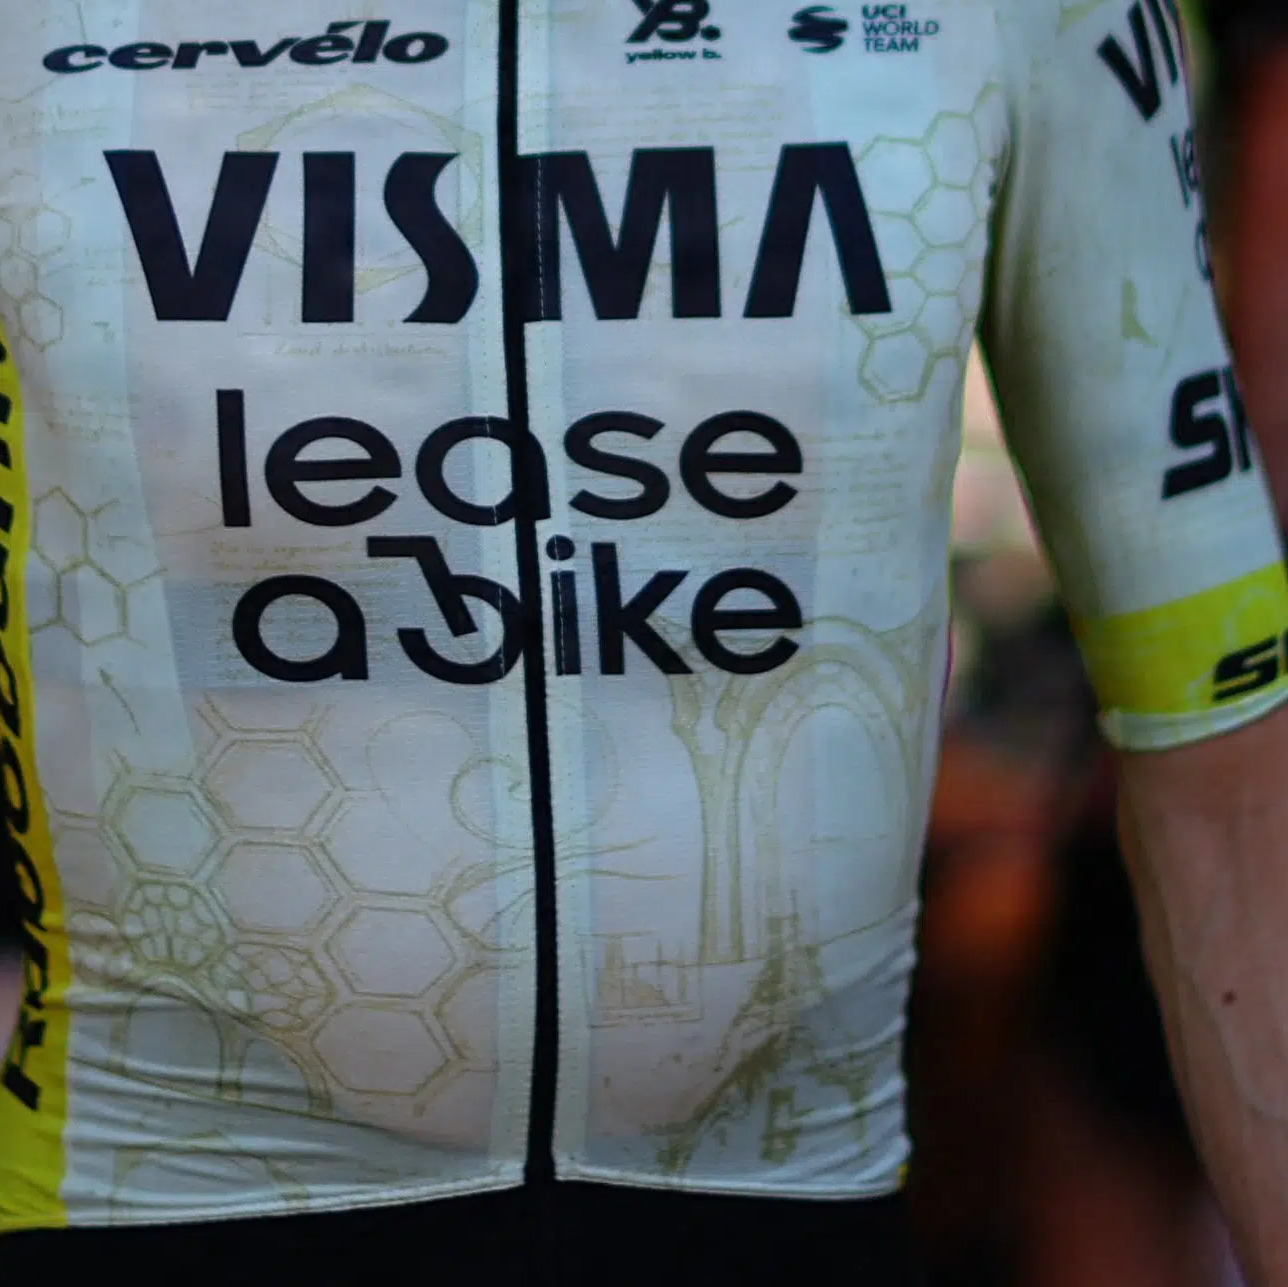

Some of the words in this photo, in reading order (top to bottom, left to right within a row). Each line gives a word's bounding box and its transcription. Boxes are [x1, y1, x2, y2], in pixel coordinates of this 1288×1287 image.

[861, 4, 907, 19] UCI
[862, 20, 940, 37] WORLD
[42, 20, 450, 74] cervélo
[862, 37, 920, 53] TEAM
[625, 49, 697, 63] yellow
[103, 142, 893, 324] VISMA
[216, 388, 804, 528] lease
